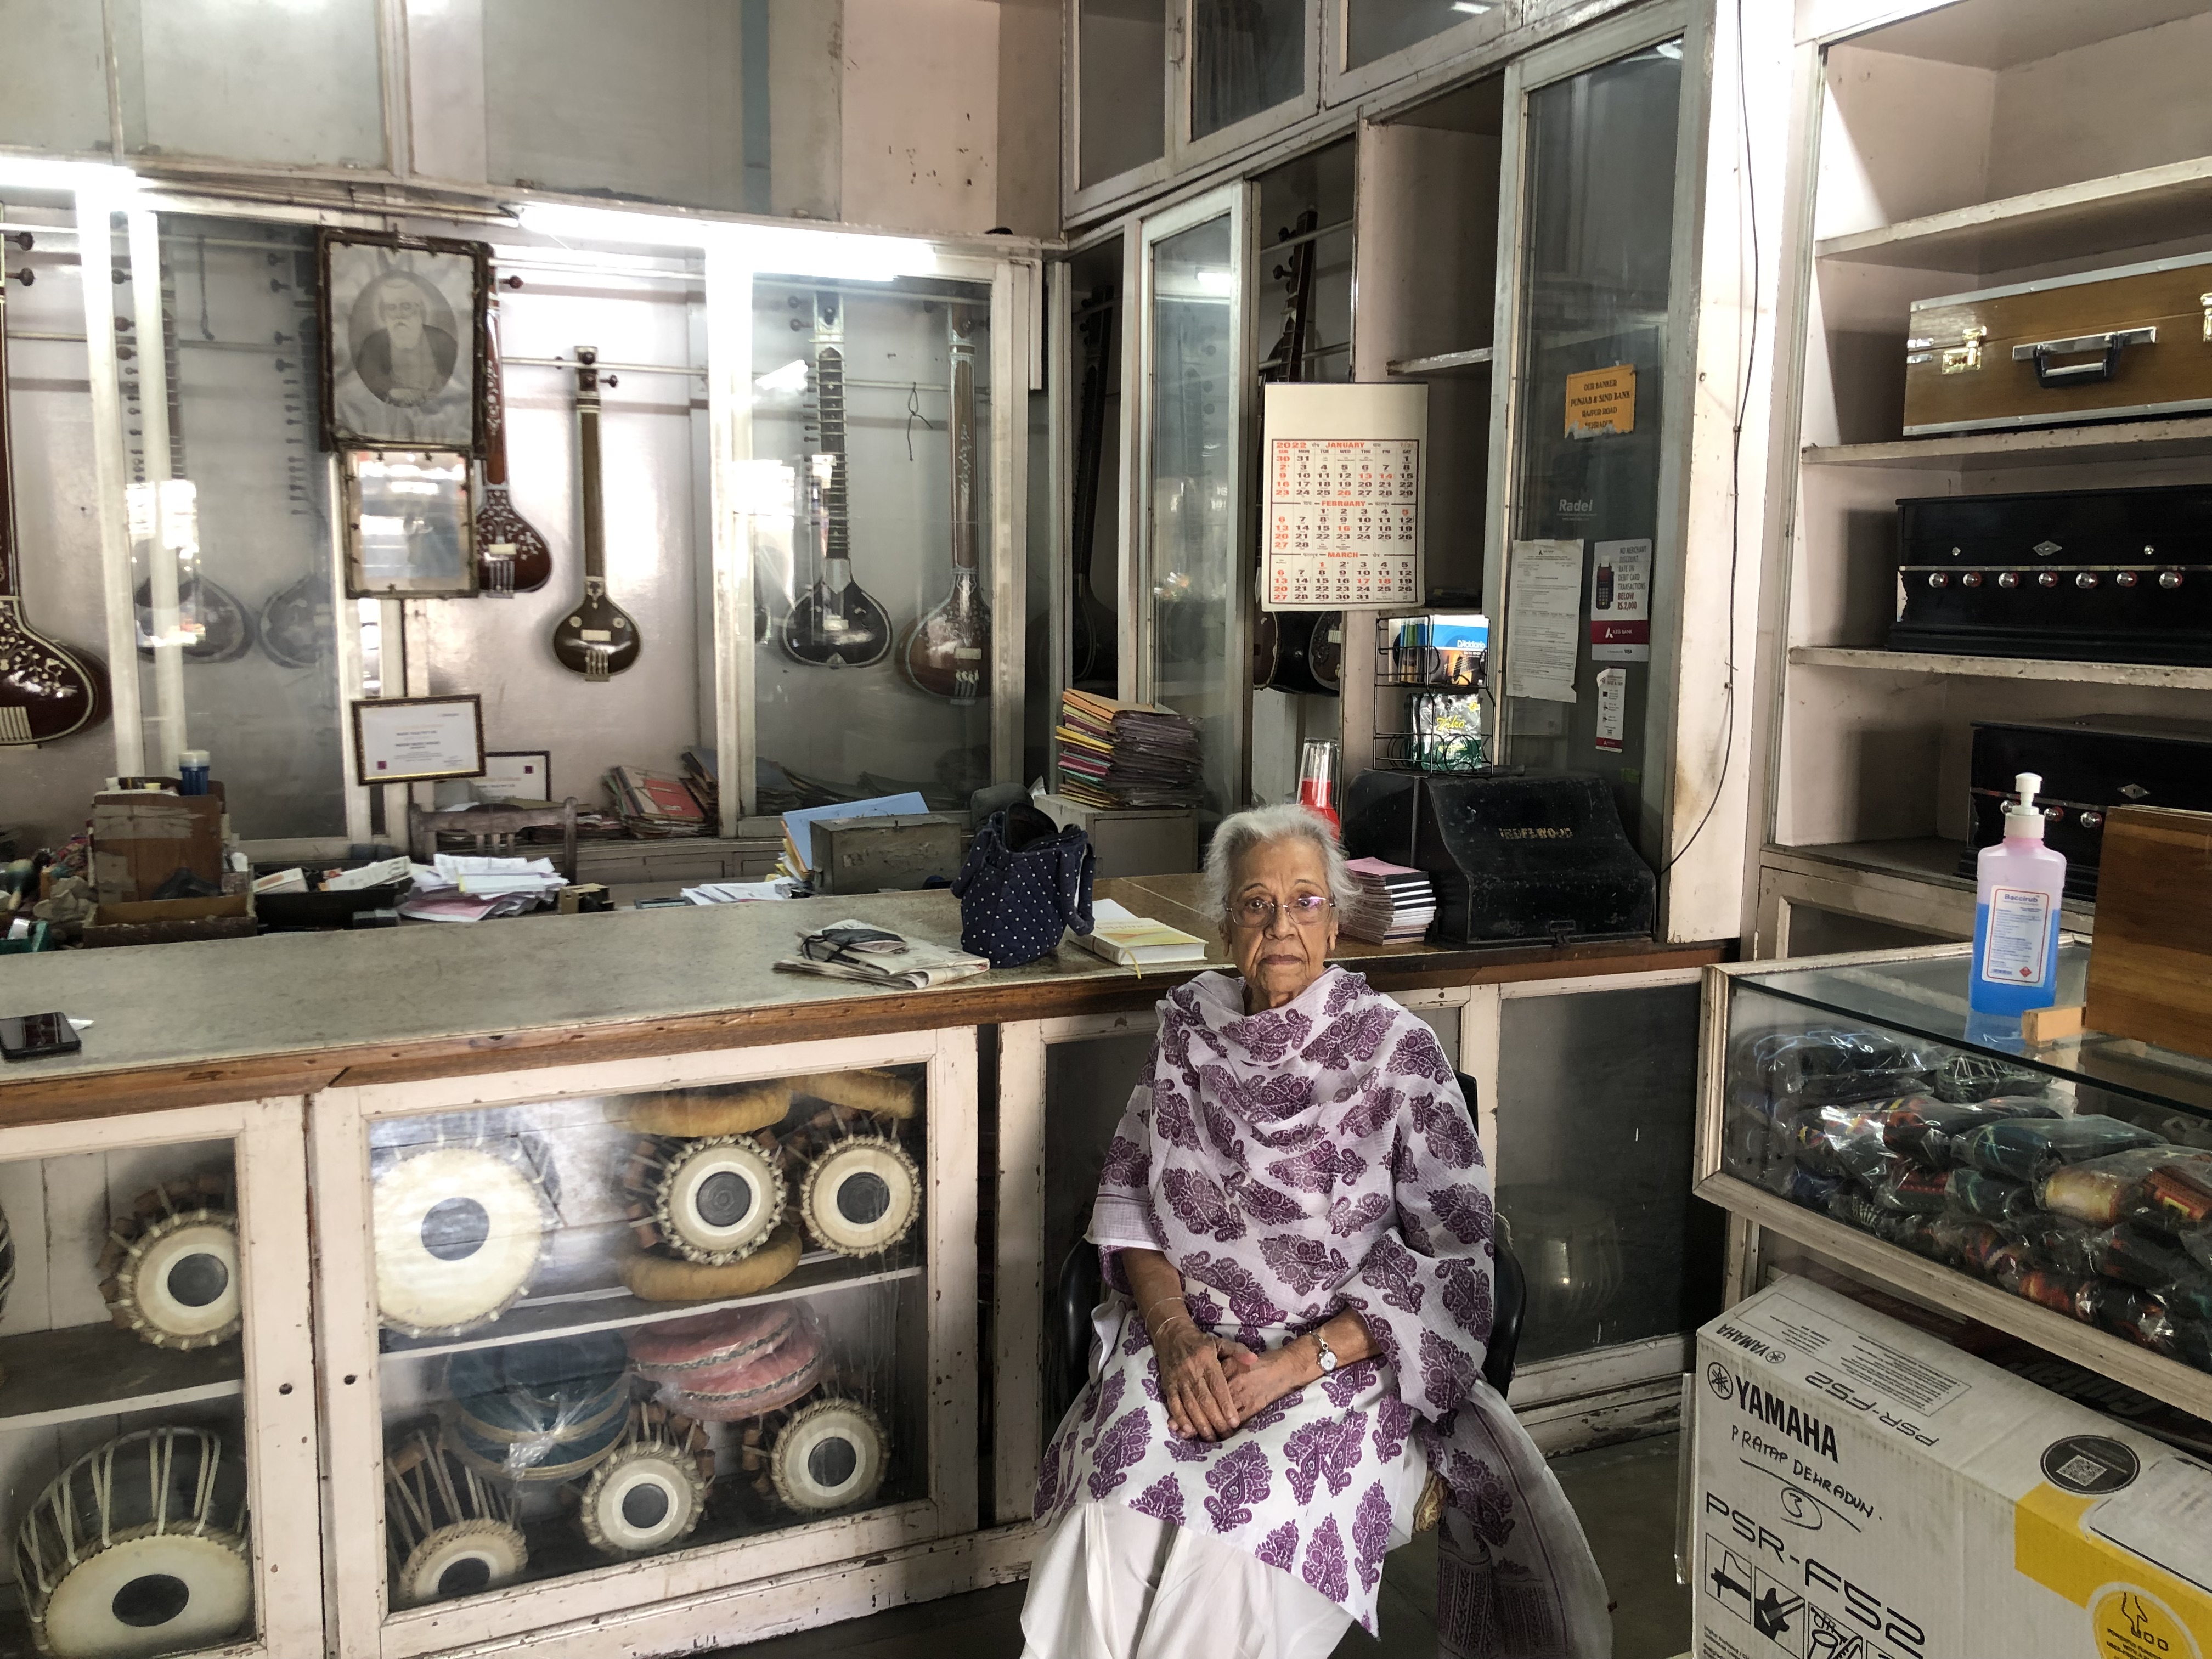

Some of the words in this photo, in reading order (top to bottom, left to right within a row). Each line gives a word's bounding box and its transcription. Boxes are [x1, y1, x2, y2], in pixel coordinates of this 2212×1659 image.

[1584, 382, 1594, 391] OUR
[1595, 380, 1617, 389] BANKER
[1571, 396, 1592, 407] PUNJAB
[1599, 393, 1613, 402] SIND
[1614, 391, 1630, 400] BANK
[1602, 407, 1617, 415] ROAD
[1559, 499, 1593, 511] Radel
[2005, 894, 2038, 902] Baccirub
[1717, 1323, 1770, 1363] YAMAHA
[1736, 1376, 1838, 1463] YAMAHA
[1731, 1424, 1788, 1464] PRATAP
